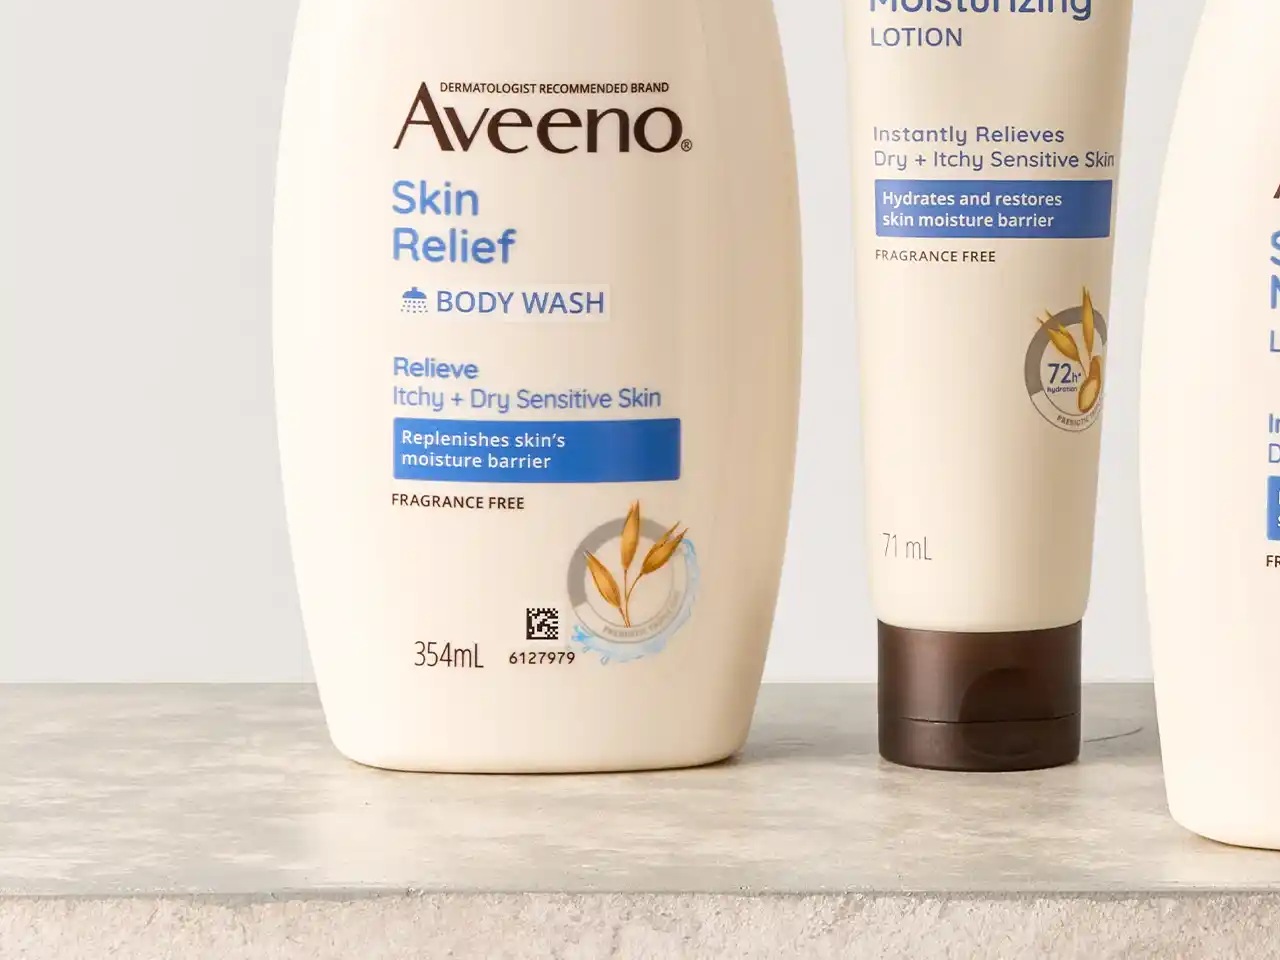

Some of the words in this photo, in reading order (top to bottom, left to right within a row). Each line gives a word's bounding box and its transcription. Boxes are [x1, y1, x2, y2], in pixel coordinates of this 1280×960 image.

[870, 27, 962, 47] LOTION
[440, 82, 537, 94] DERMATOLOGIST
[539, 83, 628, 94] RECOMMENDED
[631, 82, 670, 93] BRAND
[873, 126, 968, 146] Instantly
[976, 127, 1065, 142] Relieves
[874, 150, 907, 170] Dry
[915, 155, 926, 166] +
[934, 151, 983, 171] Itchy
[991, 152, 1079, 167] Sensitive
[1085, 152, 1115, 167] Skin
[392, 180, 479, 216] Skin
[882, 191, 955, 207] Hydrates
[959, 191, 990, 206] and
[995, 192, 1063, 206] restores
[882, 212, 914, 227] skin
[918, 213, 993, 227] moisture
[998, 213, 1055, 227] barrier
[393, 227, 517, 264] Relief
[875, 249, 958, 262] FRAGRANCE
[962, 250, 996, 262] FREE
[437, 290, 514, 314] BODY
[521, 291, 605, 314] WASH
[393, 357, 479, 379] Relieve
[393, 385, 445, 412] Itchy
[451, 394, 463, 407] +
[470, 390, 510, 413] Dry
[517, 389, 612, 409] Sensitive
[618, 389, 662, 408] Skin
[402, 430, 510, 449] Replenishes
[402, 451, 482, 468] moisture
[488, 452, 551, 469] barrier
[392, 494, 484, 509] FRAGRANCE
[488, 497, 525, 510] FREE
[883, 532, 898, 558] 71
[905, 536, 933, 561] mL
[414, 641, 484, 668] 354mL
[508, 651, 576, 666] 6127979
